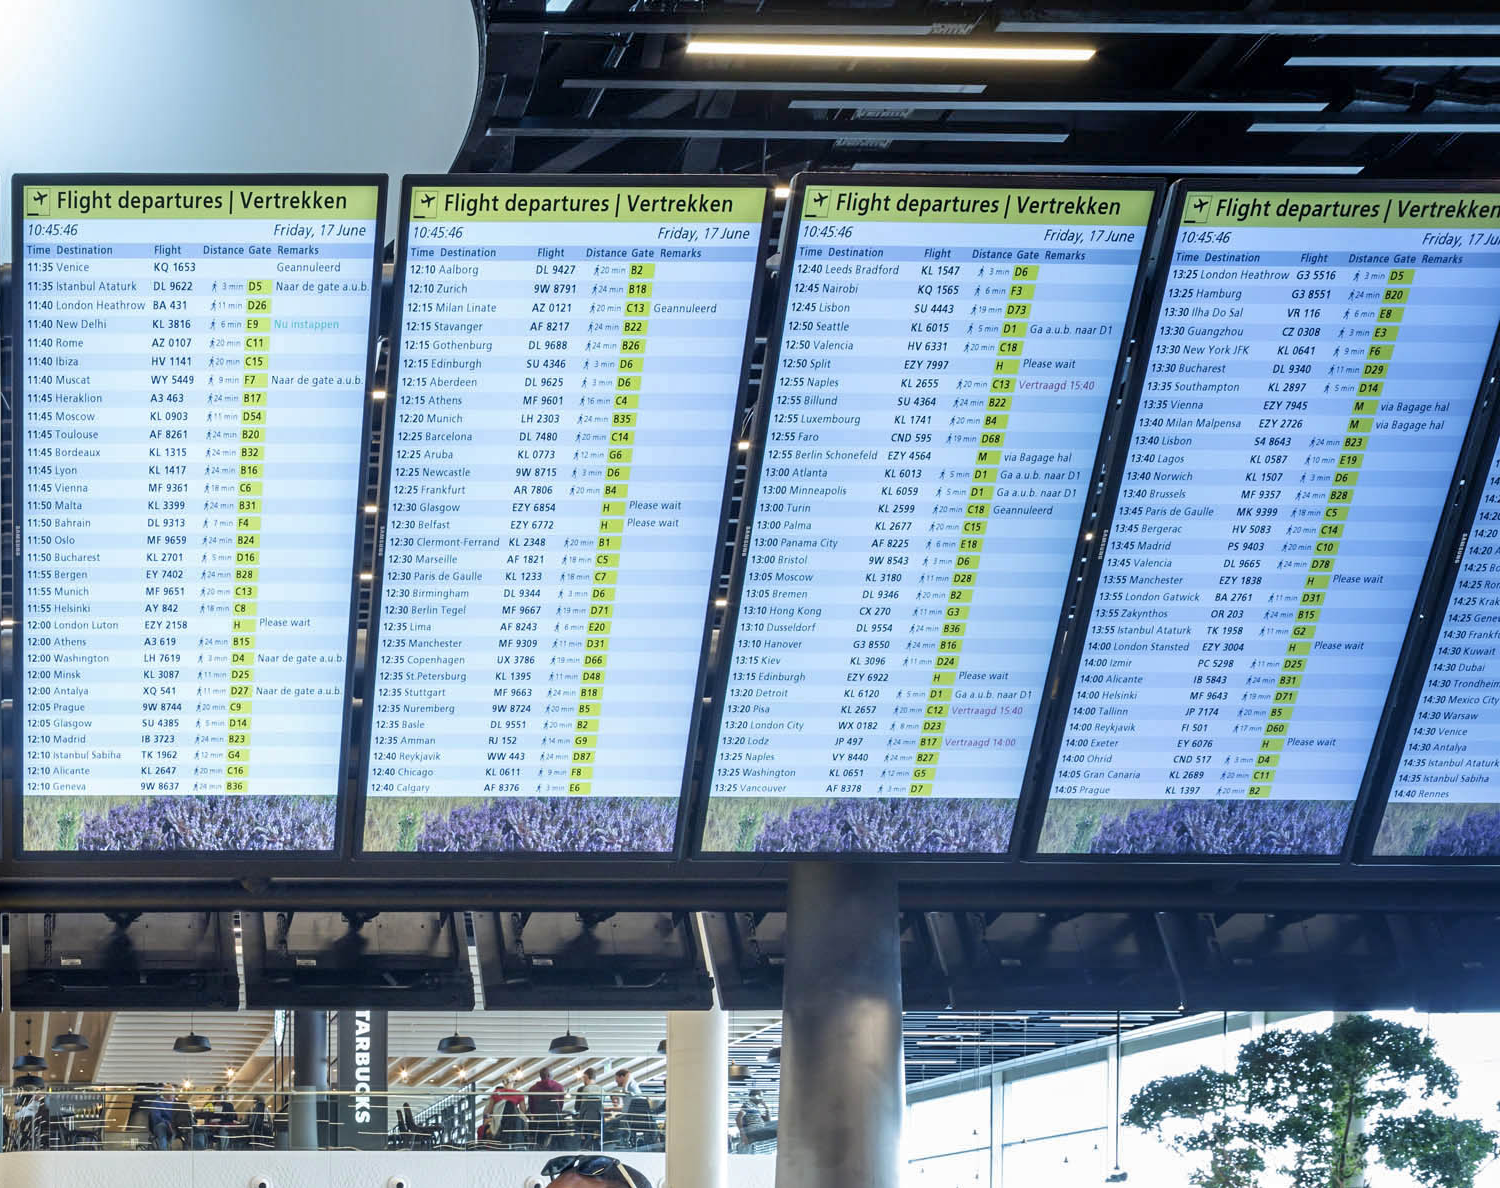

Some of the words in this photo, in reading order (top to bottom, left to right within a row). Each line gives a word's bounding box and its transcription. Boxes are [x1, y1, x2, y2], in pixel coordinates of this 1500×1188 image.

[58, 191, 111, 213] Flight
[119, 191, 222, 213] departures
[240, 191, 346, 208] Vertrekken
[445, 193, 499, 215] Flight
[505, 193, 609, 215] departures
[628, 194, 732, 212] Vertrekken
[837, 192, 891, 212] Flight
[897, 193, 999, 216] departures
[1018, 196, 1120, 215] Vertrekken
[1216, 198, 1271, 218] Flight
[1276, 199, 1380, 222] departures
[29, 224, 78, 236] 10:45:46
[274, 224, 314, 239] Friday,
[322, 224, 334, 236] 17
[337, 225, 366, 236] June
[415, 227, 463, 238] 10:45:46
[658, 227, 698, 242] Friday,
[706, 228, 719, 239] 17
[718, 228, 750, 239] June
[804, 226, 853, 238] 10:45:46
[1044, 229, 1083, 244] Friday,
[1091, 230, 1106, 241] 17
[1103, 230, 1134, 242] June
[1182, 232, 1232, 243] 10:45:46
[1423, 233, 1461, 248] Friday,
[1469, 233, 1485, 245] 17
[411, 248, 434, 256] Time
[441, 248, 496, 256] Destination
[538, 248, 564, 259] Flight
[587, 248, 627, 257] Distance
[632, 249, 654, 257] Gate
[661, 248, 701, 257] Remarks
[28, 263, 53, 271] 11:35
[56, 263, 89, 272] Venice
[154, 263, 168, 272] KQ
[174, 263, 195, 271] 1653
[277, 262, 340, 272] Geannuleerd
[798, 264, 822, 273] 12:40
[826, 264, 852, 273] Leeds
[856, 264, 899, 274] Bradford
[922, 266, 932, 275] KL
[939, 266, 960, 275] 1547
[1015, 267, 1028, 276] D6
[1174, 270, 1198, 279] 13:25
[1201, 269, 1237, 279] London
[1241, 270, 1289, 279] Heathrow
[1297, 271, 1310, 279] G3
[1313, 271, 1336, 280] 5516
[1390, 271, 1404, 280] D5
[408, 303, 432, 312] 12:15
[436, 303, 463, 312] Milan
[467, 304, 496, 312] Linate
[532, 303, 545, 312] AZ
[549, 303, 571, 312] 0121
[627, 304, 644, 312] C13
[654, 304, 717, 313] Geannuleerd
[1157, 345, 1180, 353] 13:30
[1183, 345, 1203, 354] New
[1209, 345, 1229, 354] York
[1233, 346, 1249, 354] JFK
[1278, 346, 1288, 355] KL
[1293, 346, 1315, 355] 0641
[780, 378, 804, 386] 12:55
[807, 377, 838, 389] Naples
[1020, 381, 1067, 392] Vertraagd
[1071, 381, 1094, 390] 15:40
[28, 621, 51, 629] 12:00
[55, 621, 88, 629] London
[92, 621, 118, 629] Luton
[145, 621, 162, 629] EZY
[166, 621, 187, 629] 2158
[260, 617, 287, 626] Please
[1483, 696, 1499, 705] City
[718, 768, 740, 776] 13:25
[743, 768, 795, 778] Washington
[1418, 790, 1449, 798] Rennes
[355, 1010, 371, 1123] TARBUCKS
